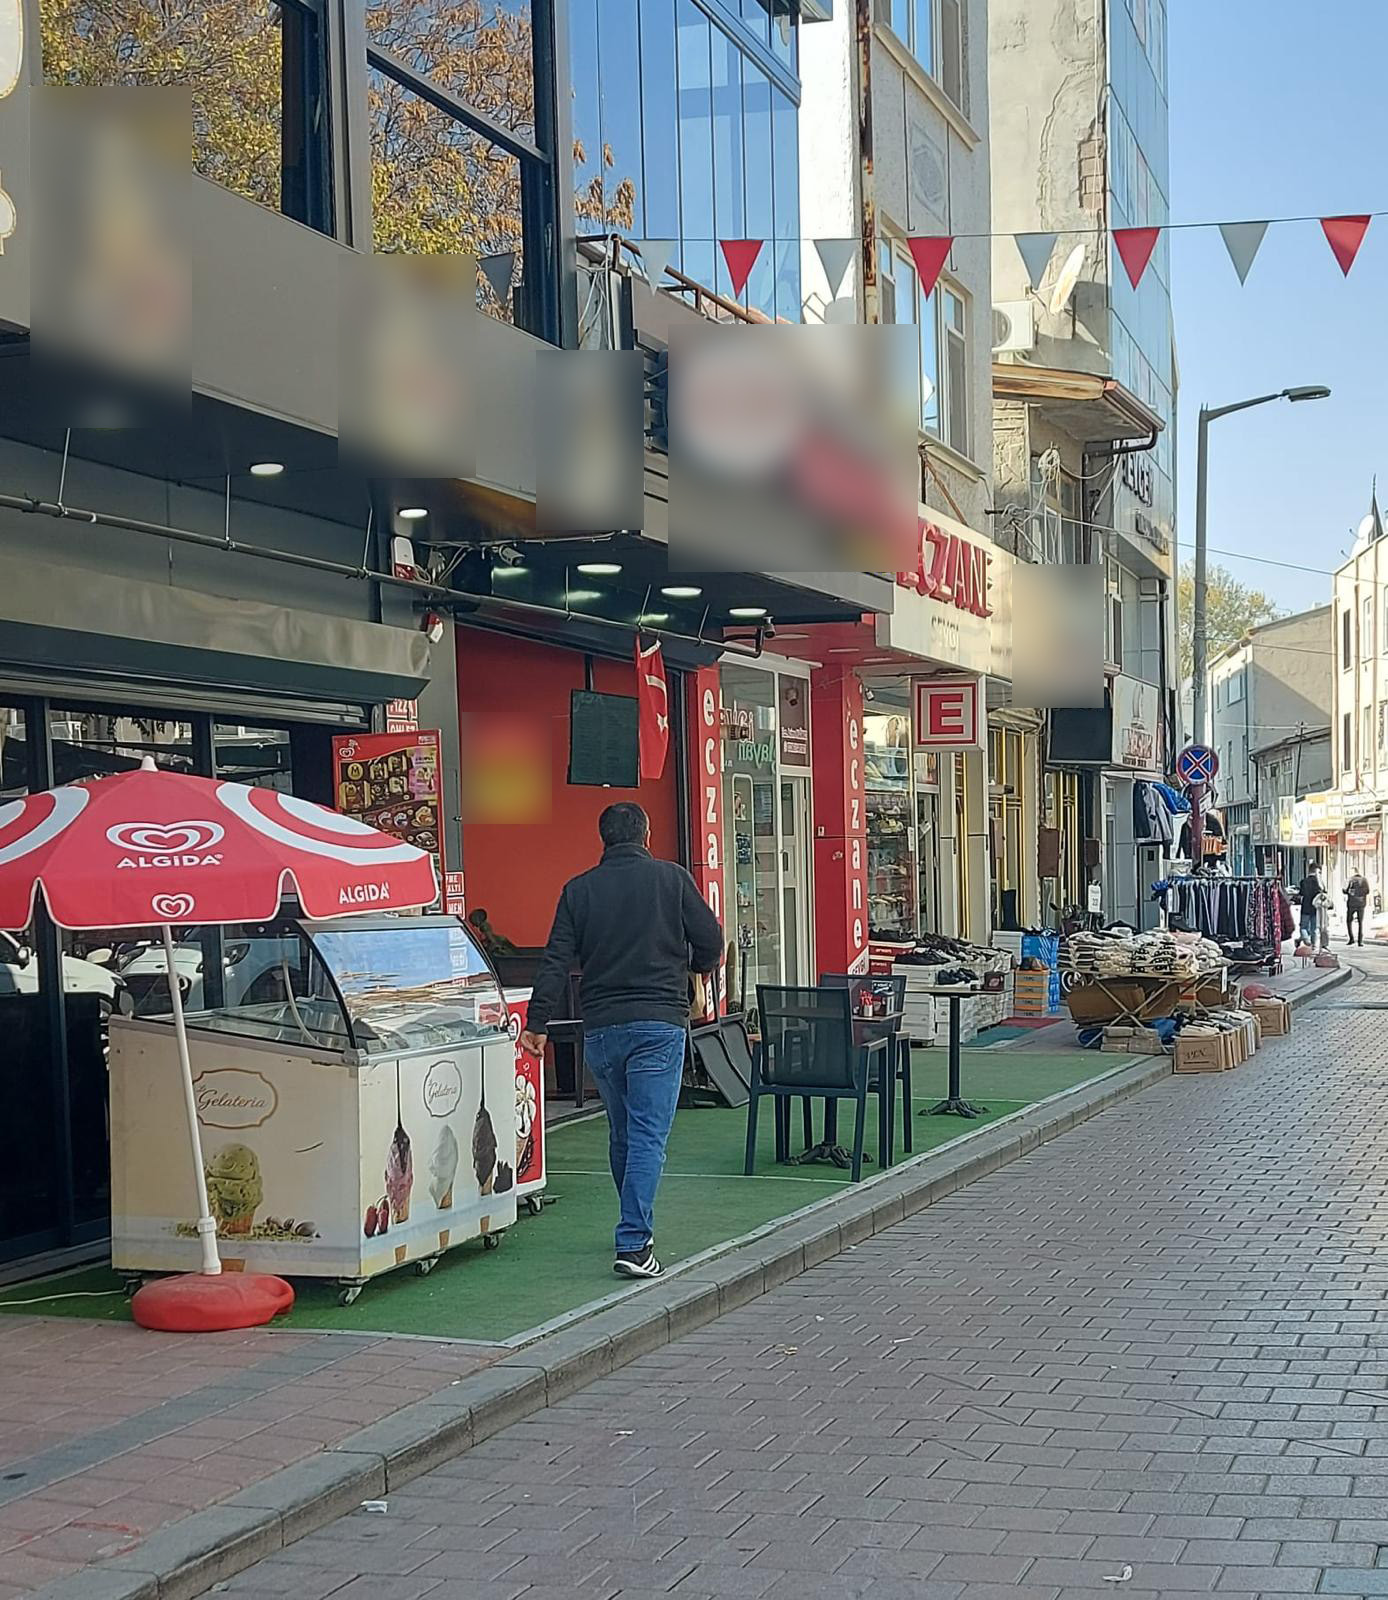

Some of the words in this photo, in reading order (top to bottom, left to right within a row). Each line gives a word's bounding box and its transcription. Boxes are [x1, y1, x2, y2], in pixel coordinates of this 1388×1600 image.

[896, 517, 993, 618] CZANE
[929, 693, 964, 735] E
[702, 687, 721, 919] eczan
[849, 721, 864, 950] eczane
[116, 854, 221, 869] ALGIDA
[338, 881, 390, 905] ALGIDA
[198, 1089, 265, 1111] Gelateria
